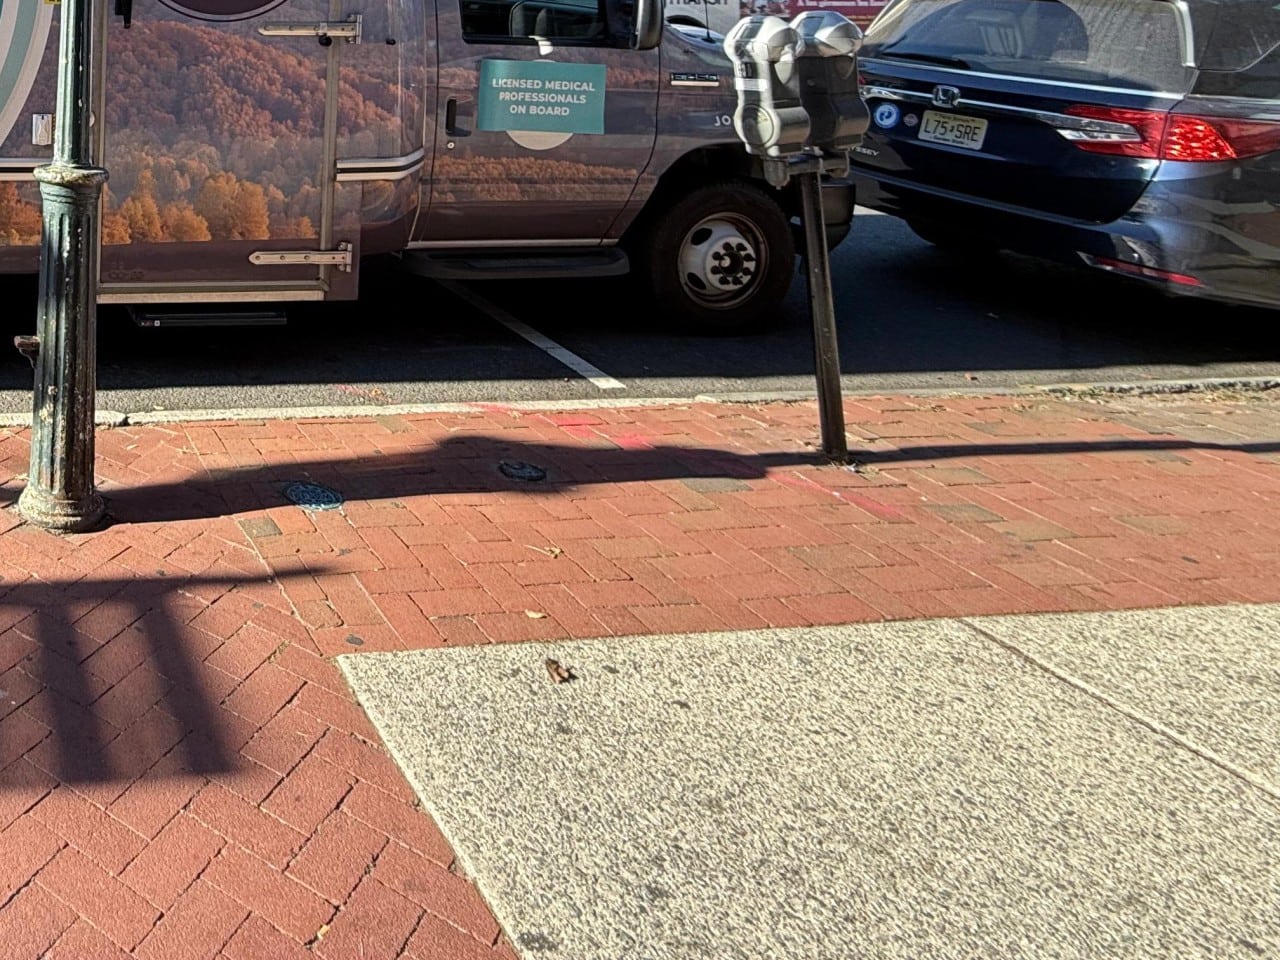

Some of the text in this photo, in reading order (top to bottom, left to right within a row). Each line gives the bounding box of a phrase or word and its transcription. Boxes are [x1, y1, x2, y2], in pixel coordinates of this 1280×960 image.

[492, 78, 595, 91] LICENSED MEDICAL
[499, 91, 587, 104] PROFESSIONALS
[509, 105, 570, 116] ON BOARD
